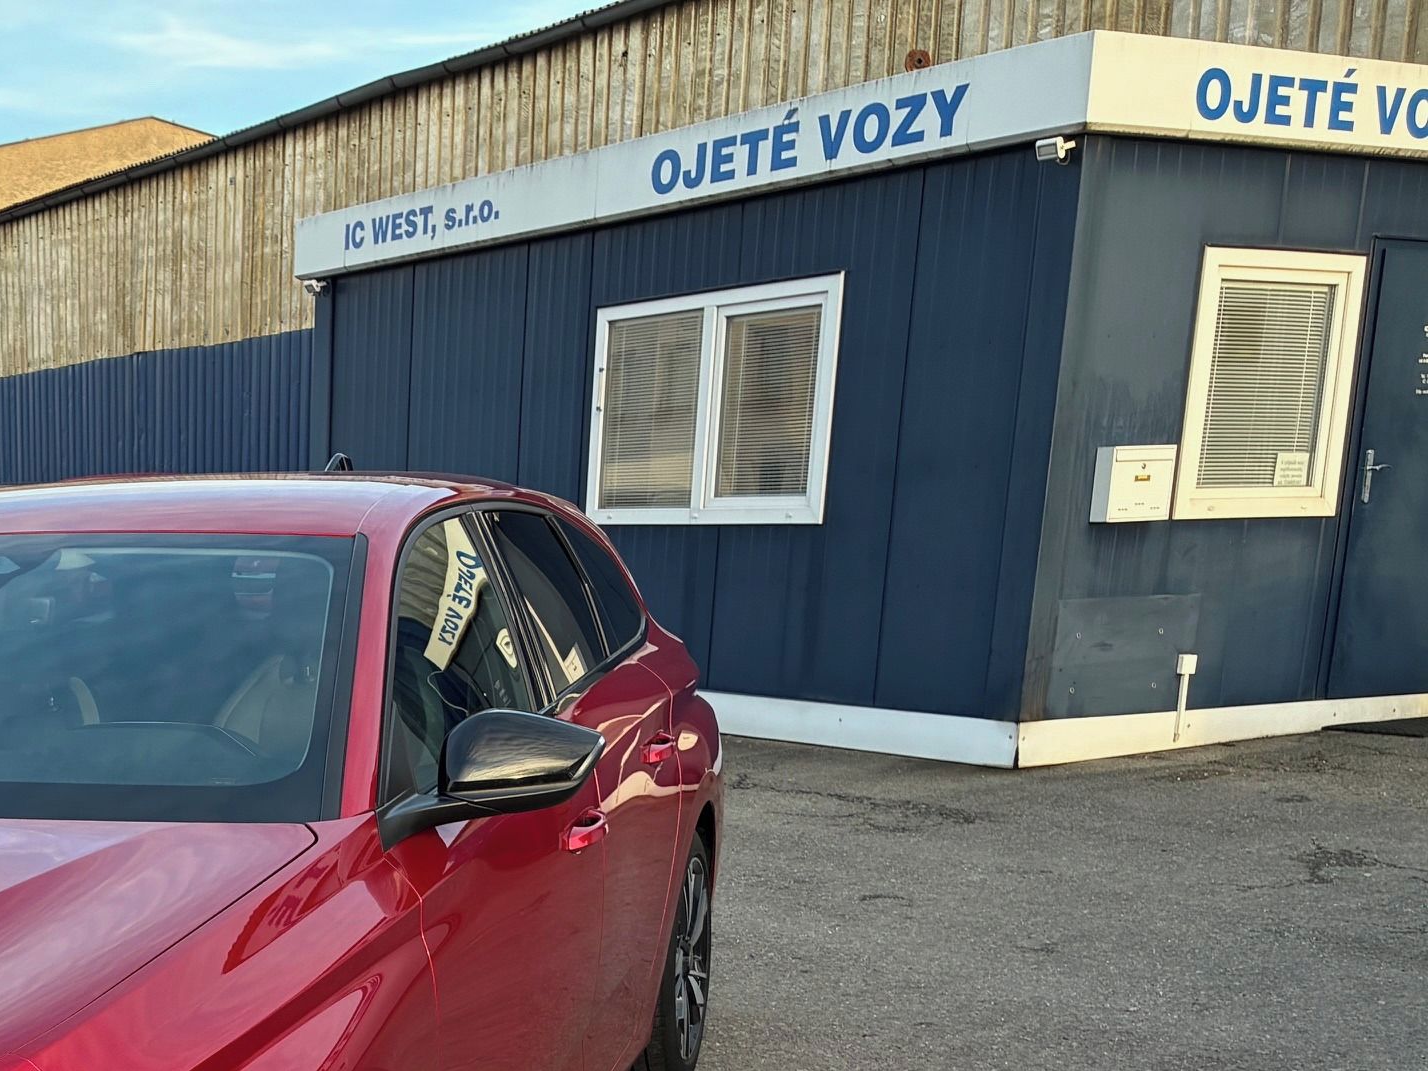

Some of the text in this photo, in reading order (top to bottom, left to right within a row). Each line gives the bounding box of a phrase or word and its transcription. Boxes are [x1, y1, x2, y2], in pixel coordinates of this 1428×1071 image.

[1196, 68, 1358, 132] OJETÉ
[651, 83, 970, 195] OJETÉ VOZY
[344, 199, 500, 250] IC WEST, s.r.o.
